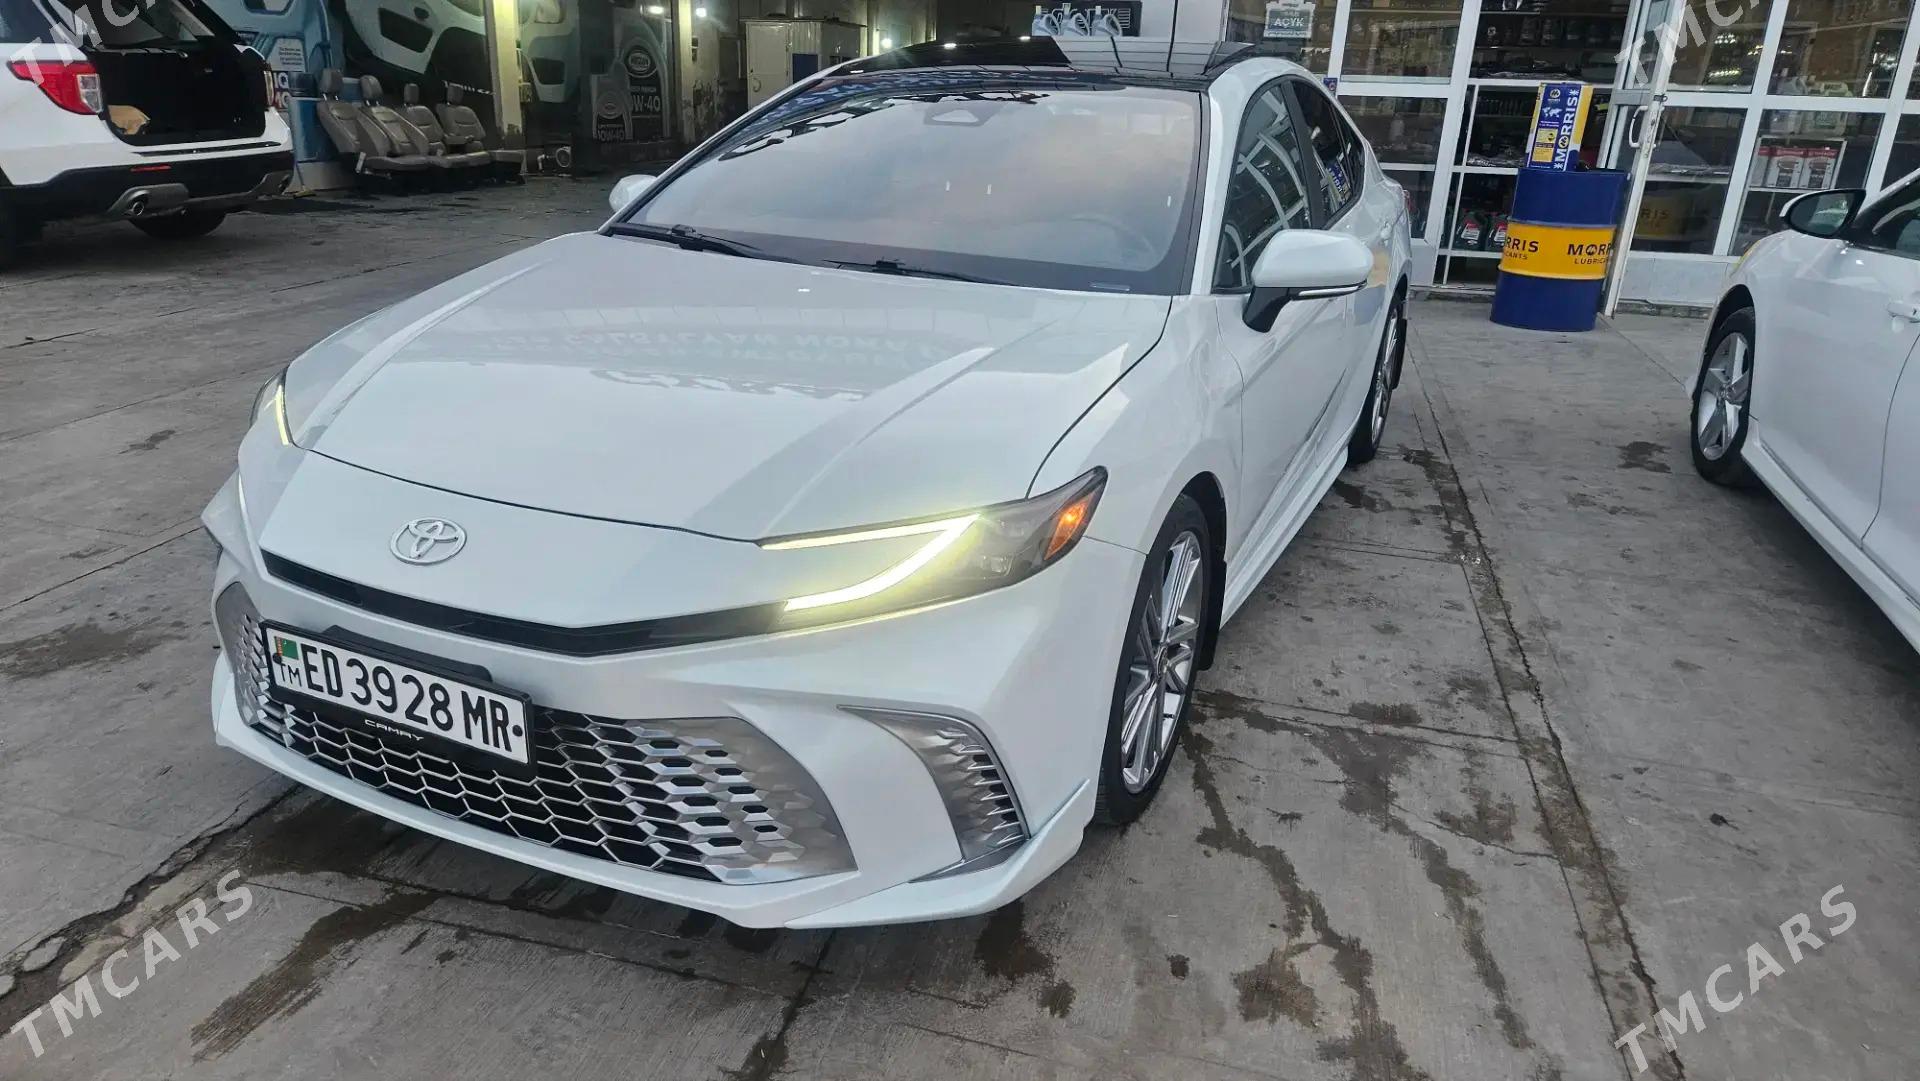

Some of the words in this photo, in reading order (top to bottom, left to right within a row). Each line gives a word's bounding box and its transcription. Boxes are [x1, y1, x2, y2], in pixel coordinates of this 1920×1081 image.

[1273, 17, 1305, 29] AÇYK
[1554, 96, 1578, 163] MORRIS
[277, 662, 302, 687] TM
[345, 658, 454, 732] 3928
[364, 718, 424, 742] CAMRY
